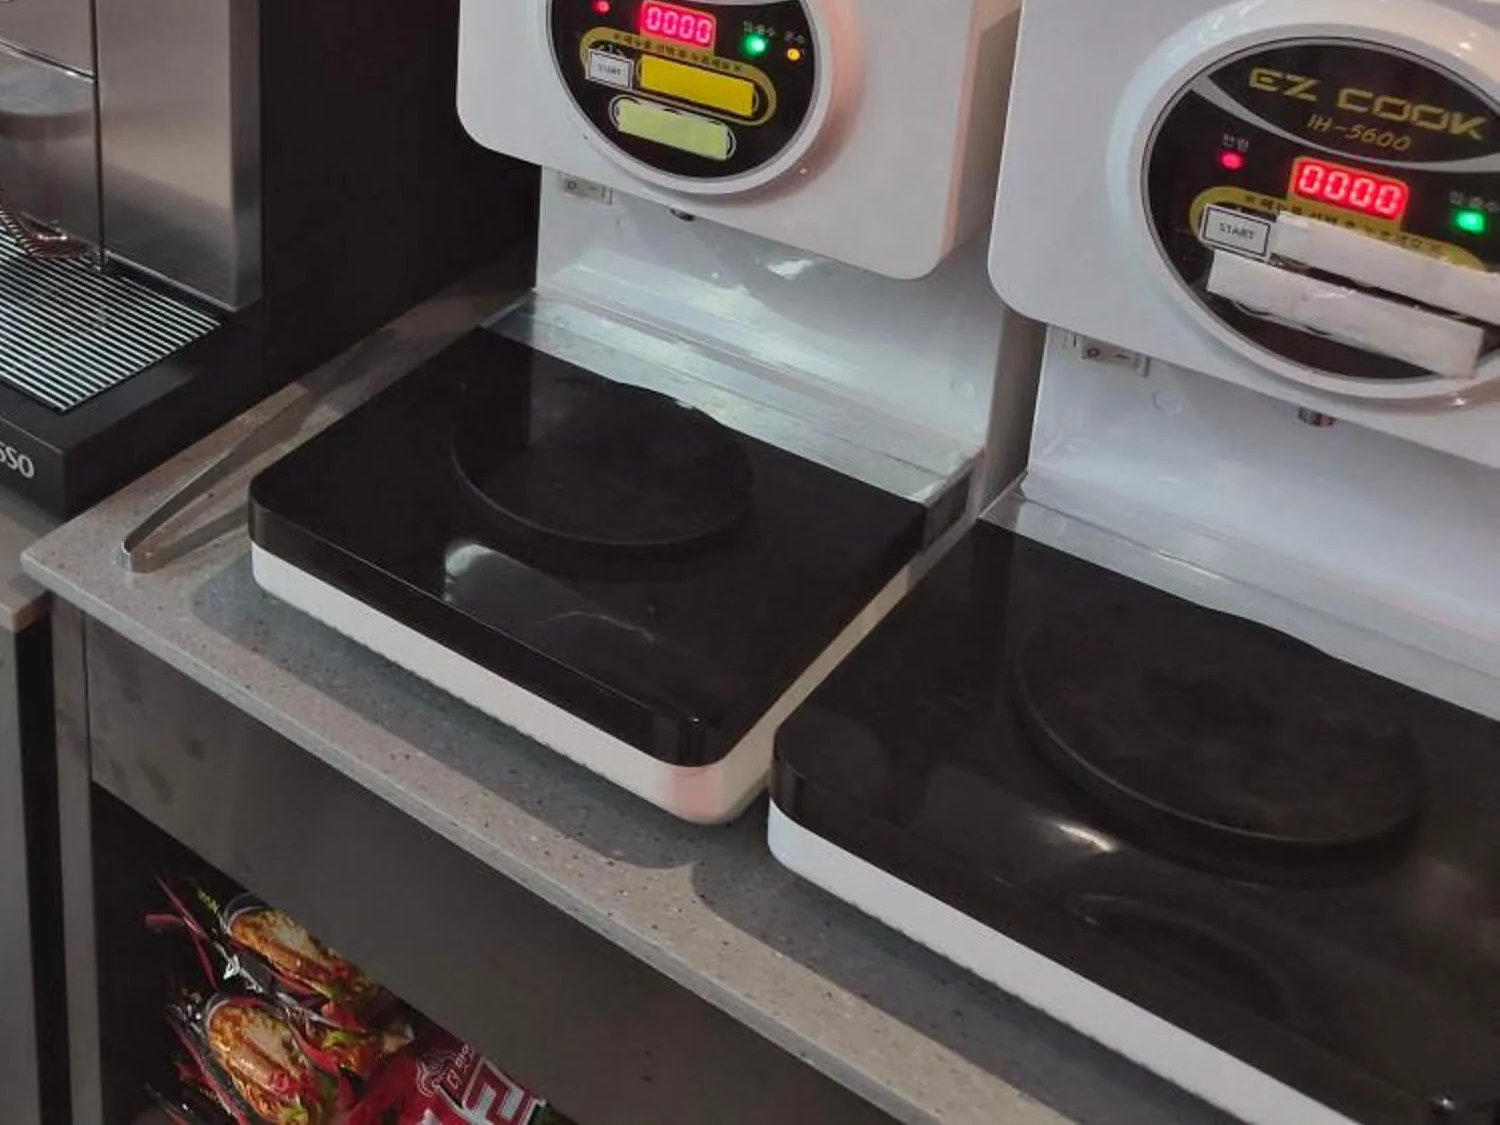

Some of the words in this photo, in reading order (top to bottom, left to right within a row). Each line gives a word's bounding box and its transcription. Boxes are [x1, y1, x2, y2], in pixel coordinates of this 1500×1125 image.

[645, 6, 713, 44] 0000
[1248, 67, 1320, 103] EZ
[1336, 87, 1487, 142] COOK
[1306, 114, 1412, 153] IH-5600
[1297, 163, 1402, 214] 0000
[1218, 222, 1256, 241] START
